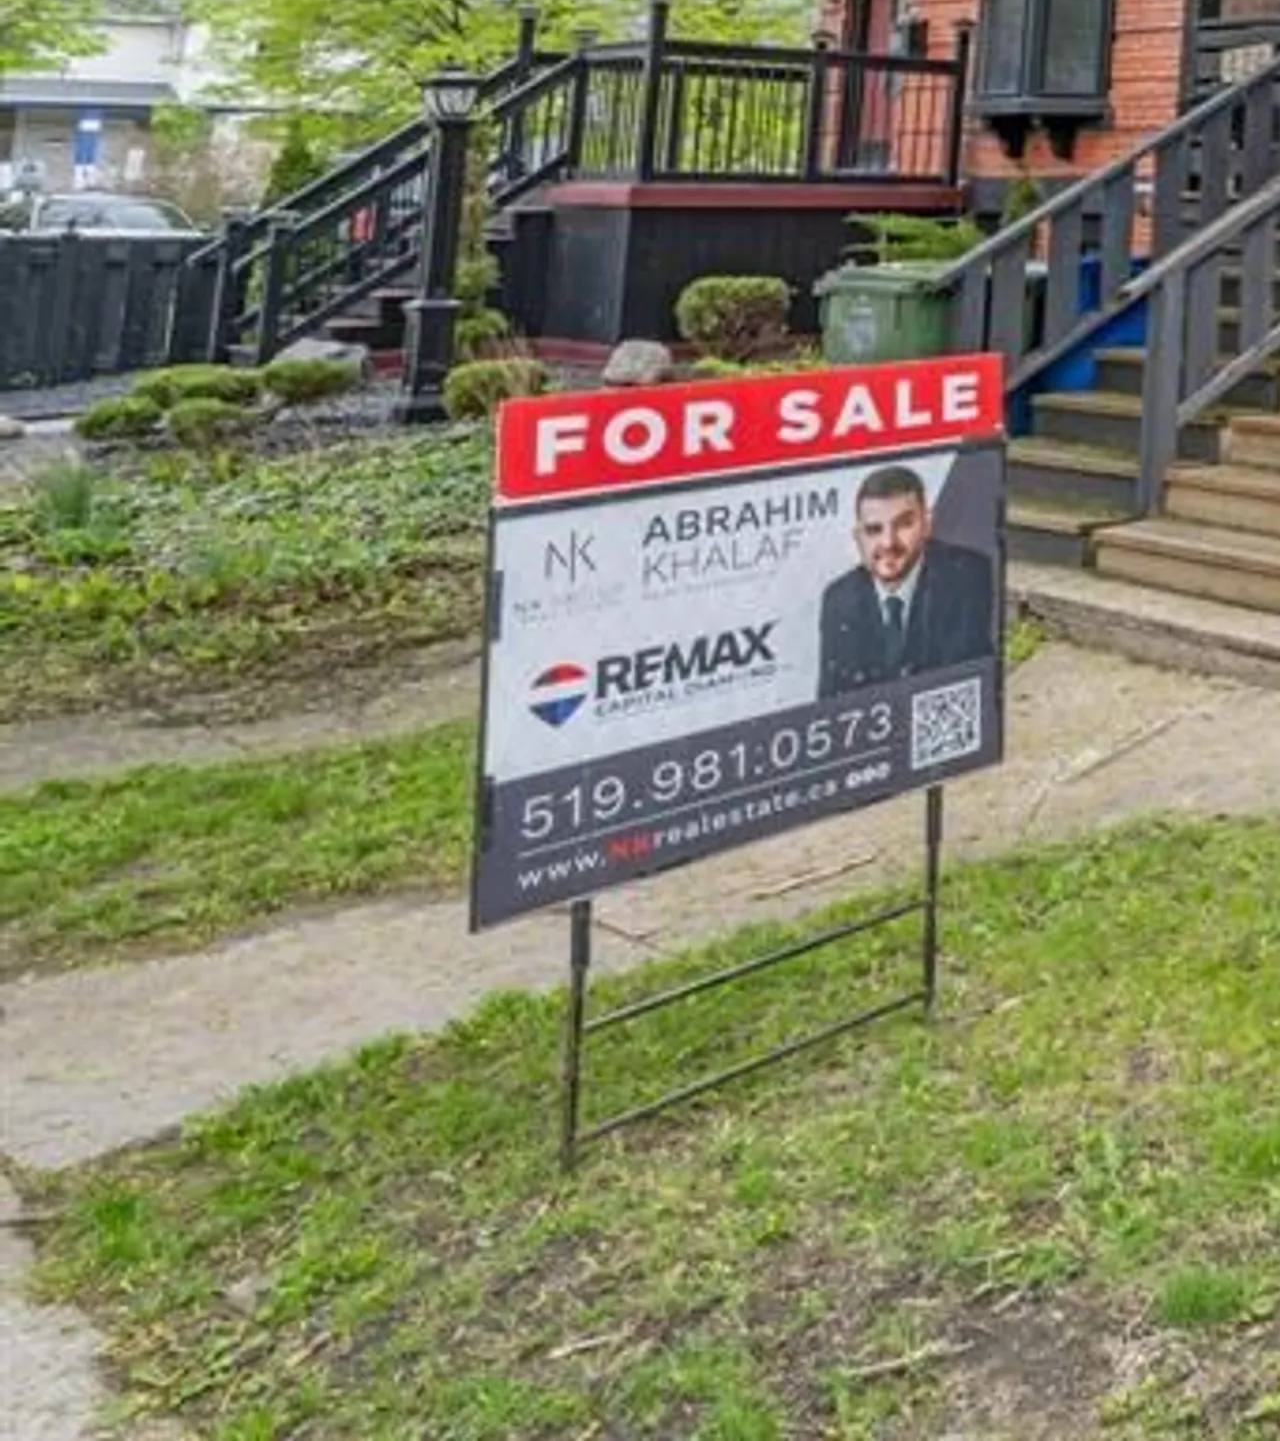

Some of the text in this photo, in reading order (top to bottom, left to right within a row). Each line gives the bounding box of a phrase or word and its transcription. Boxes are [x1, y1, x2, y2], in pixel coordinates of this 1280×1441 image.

[536, 373, 980, 476] FOR SALE
[642, 487, 840, 548] ABRAHIM
[641, 528, 804, 585] KHALAF
[594, 688, 674, 718] CAPITAL
[520, 702, 893, 841] 519.981.0573
